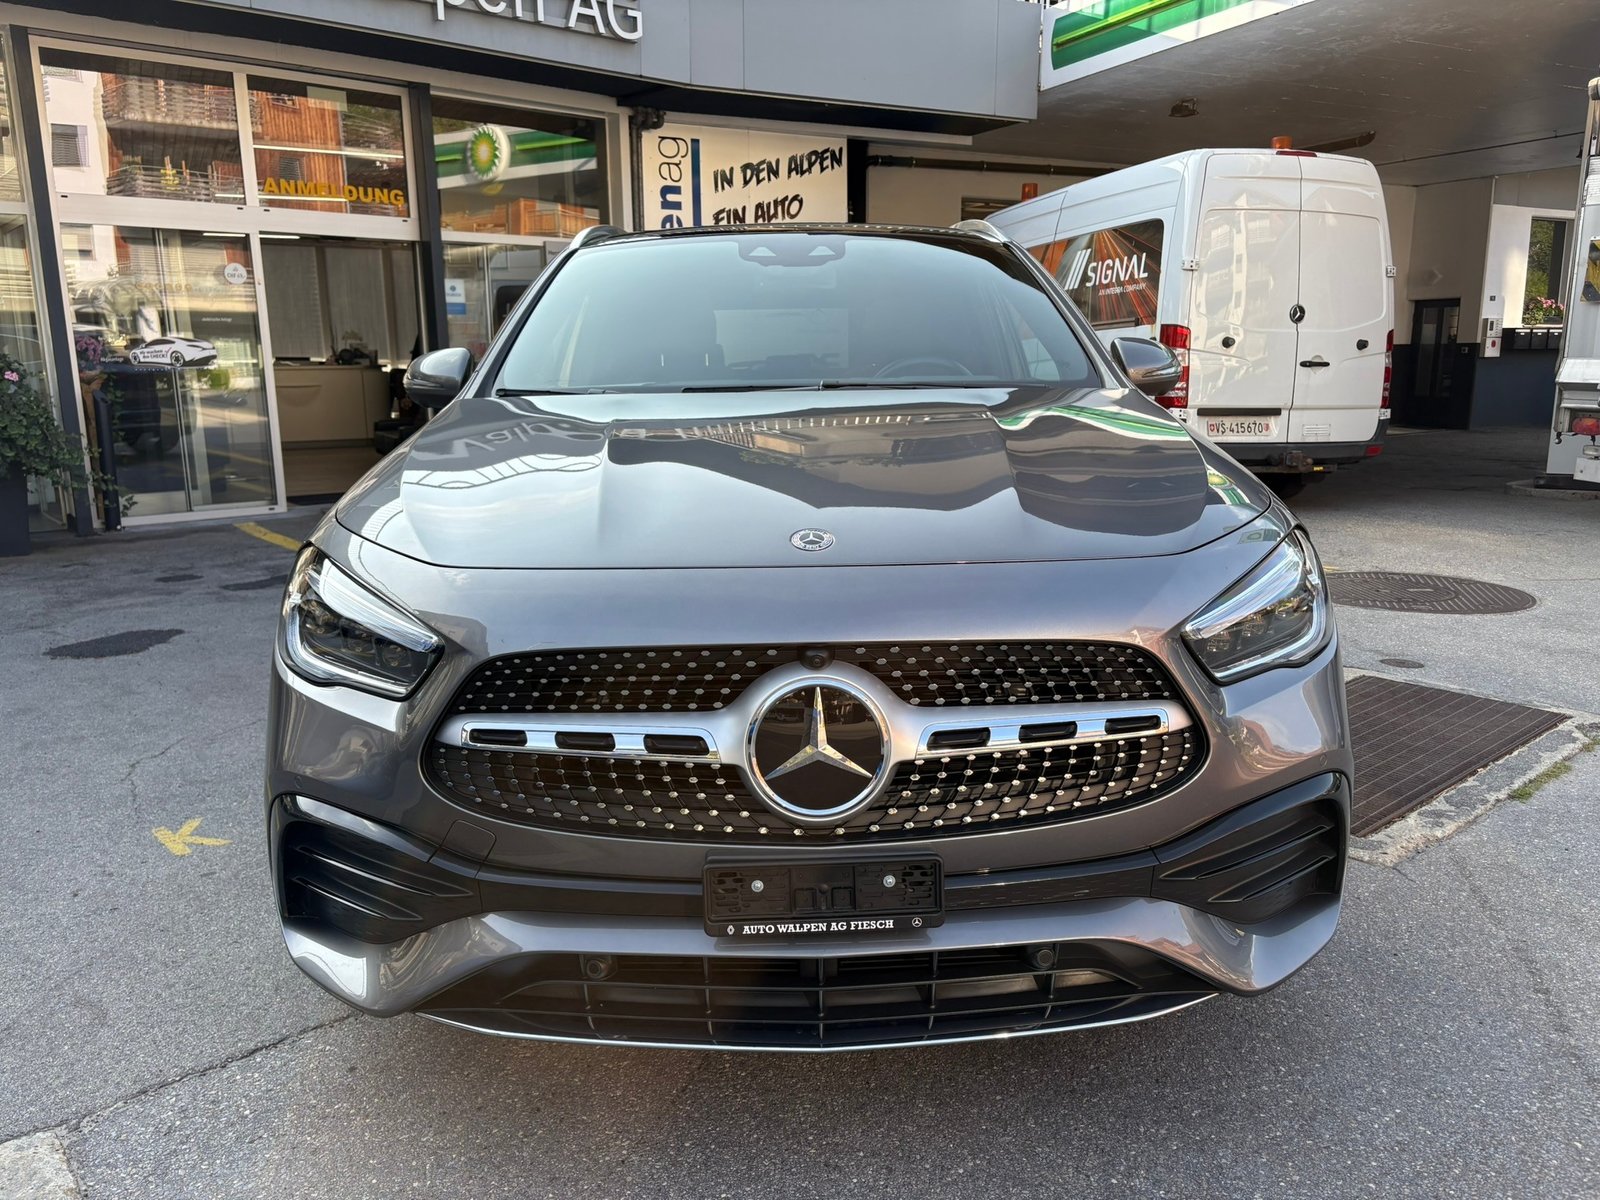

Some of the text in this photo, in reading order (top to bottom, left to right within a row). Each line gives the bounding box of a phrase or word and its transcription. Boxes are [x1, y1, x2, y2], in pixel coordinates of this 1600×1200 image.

[712, 146, 843, 193] IN DEN ALPEN
[263, 176, 406, 206] ANMELDUNG
[754, 194, 804, 224] AUTO
[1085, 252, 1149, 288] SIGNAL
[742, 919, 894, 935] AUTO WALPEN AG FIESCH
